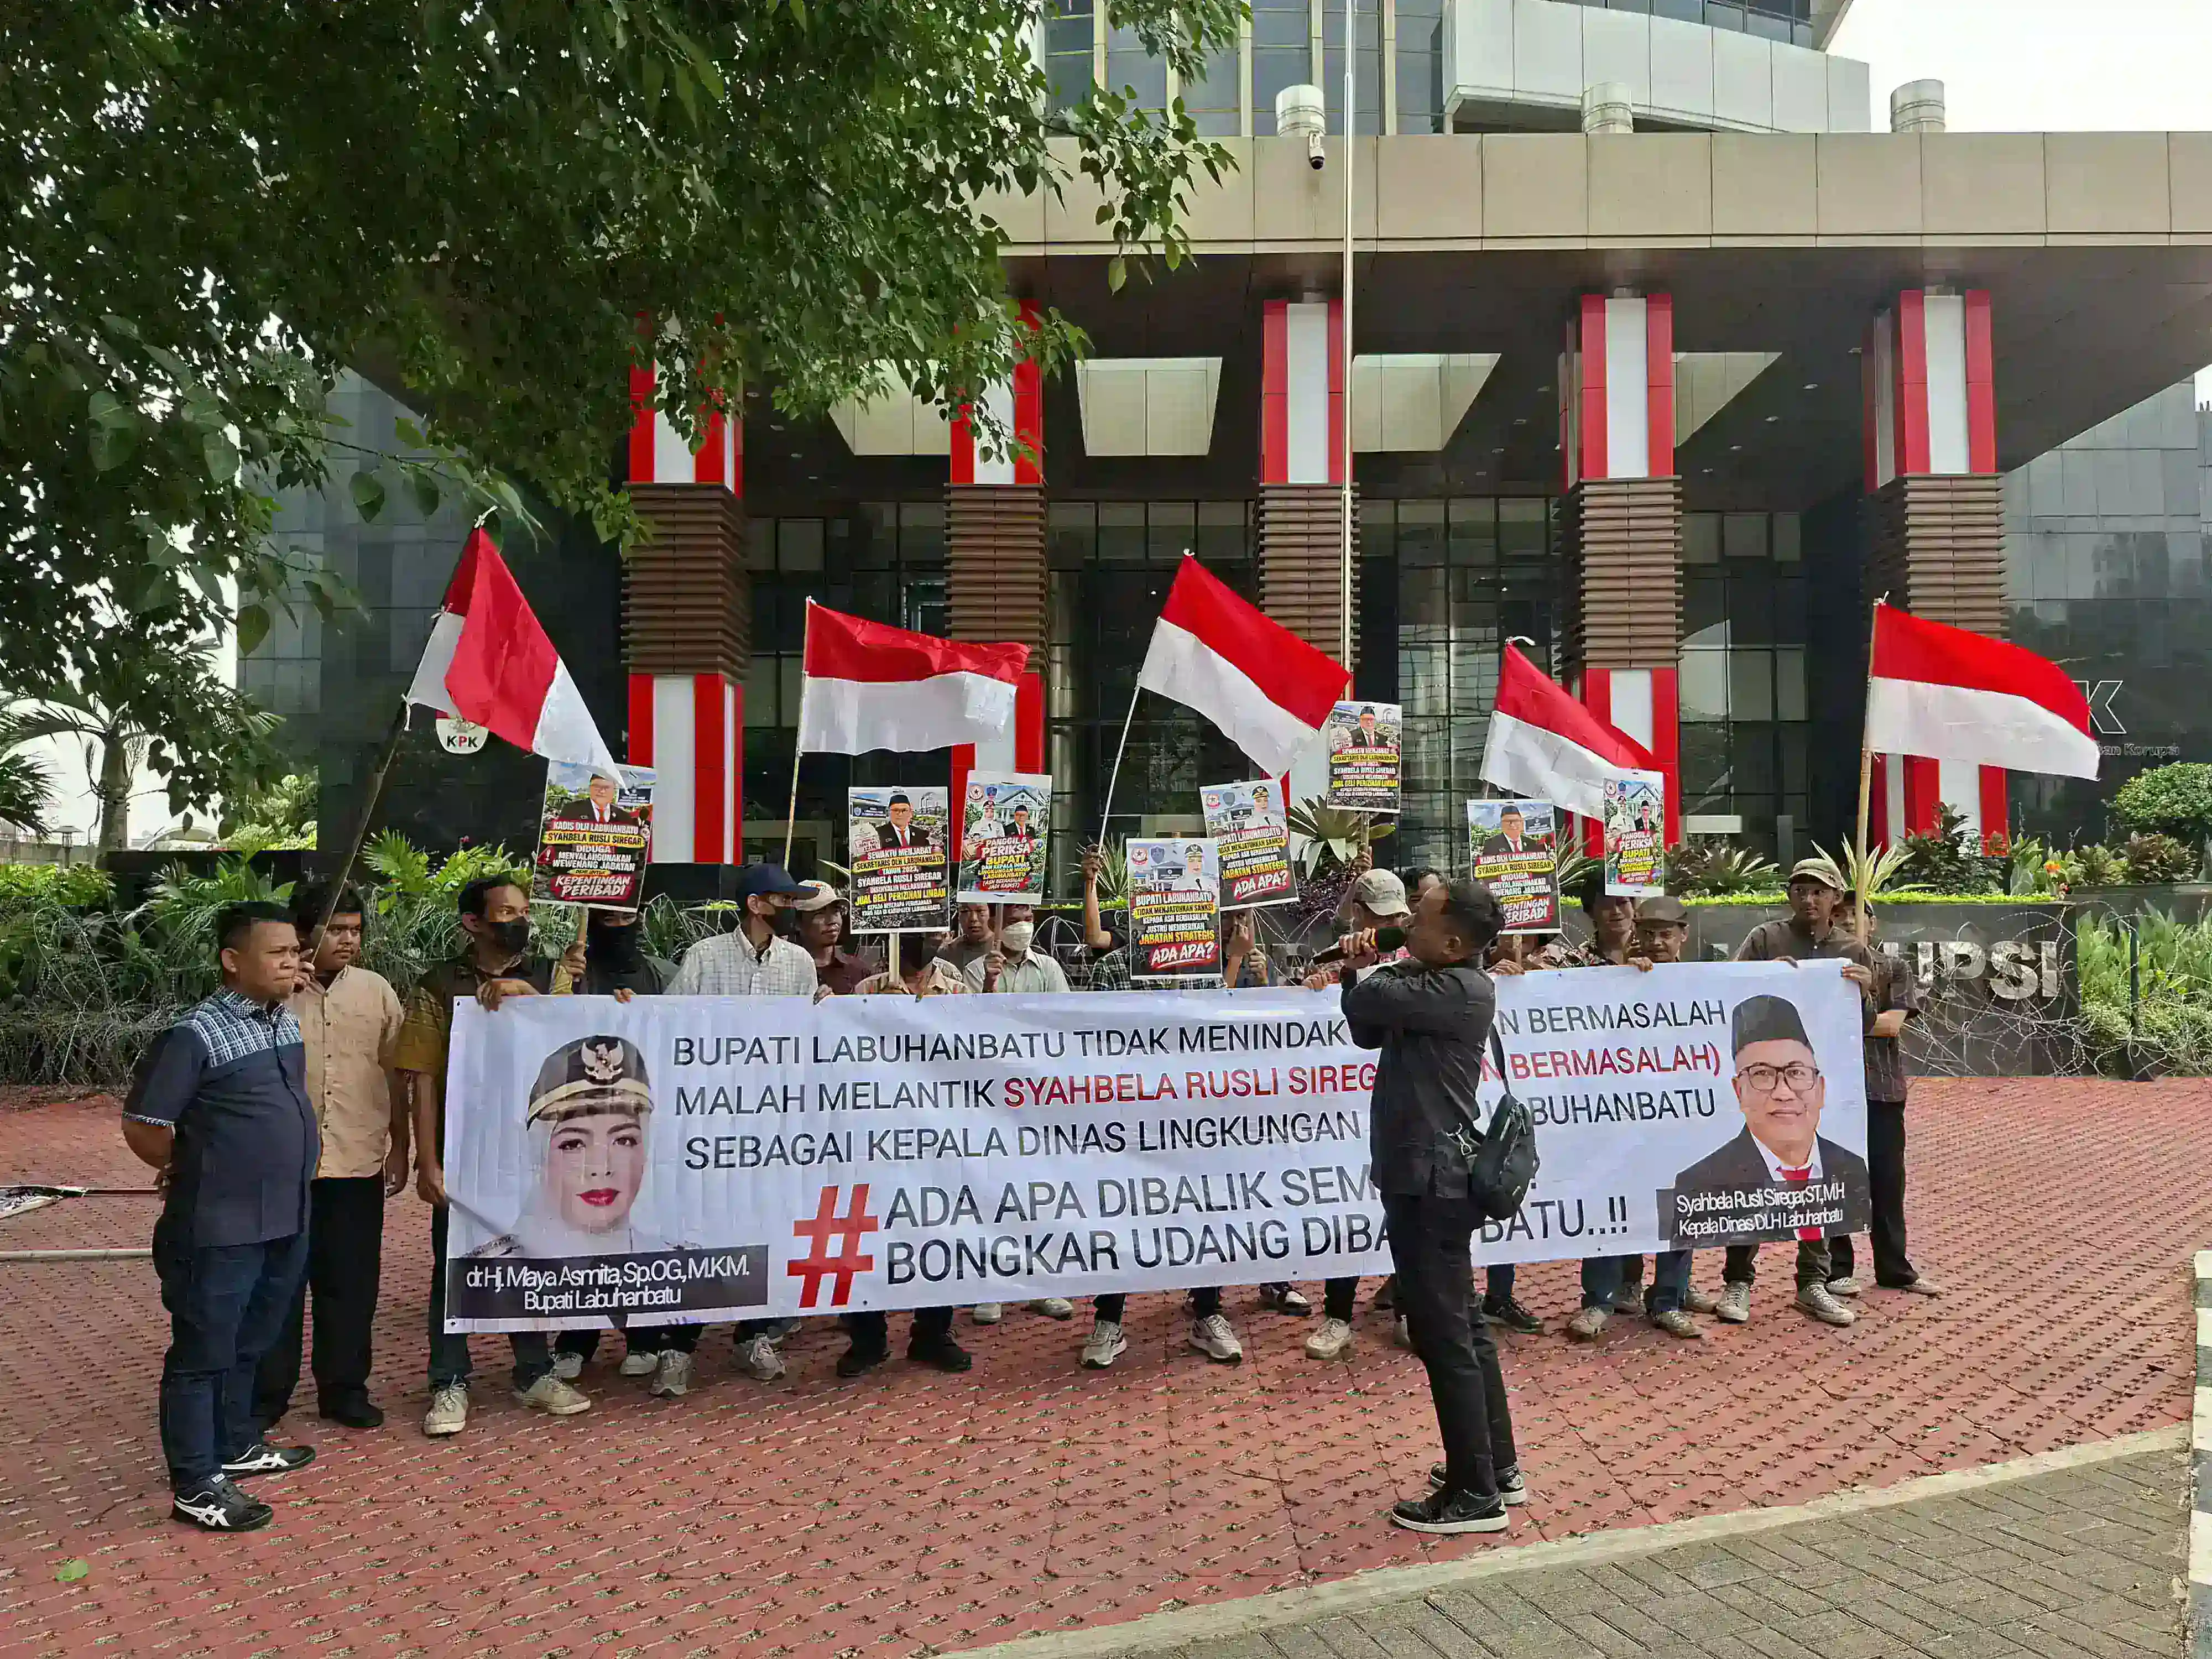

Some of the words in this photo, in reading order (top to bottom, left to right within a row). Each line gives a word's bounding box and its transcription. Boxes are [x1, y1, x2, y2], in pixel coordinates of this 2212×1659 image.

[447, 735, 478, 748] KPK
[554, 822, 574, 830] KADIS
[547, 832, 587, 842] SYAHBELA
[588, 833, 611, 843] RUSLI
[612, 835, 641, 846] SIREGAR
[985, 837, 1019, 847] PANGGIL
[1619, 837, 1653, 852] PERIKSA
[867, 850, 898, 860] SEWAKTU
[982, 844, 1031, 858] PERIKSA
[1623, 848, 1650, 859] BUPATI
[553, 859, 598, 869] WEWENANG
[857, 858, 890, 870] SEKRETARIS
[904, 855, 943, 865] LABUHANBATU
[986, 855, 1025, 865] BUPATI
[1222, 867, 1251, 879] JABATAN
[1251, 860, 1287, 874] STRATEGIS
[1478, 864, 1509, 875] SYAHBELA
[1509, 863, 1526, 872] RUSLI
[1527, 861, 1551, 870] SIREGAR
[555, 875, 631, 886] KEPENTINGAN
[857, 875, 892, 888] SYAHBELA
[893, 873, 912, 883] RUSLI
[914, 871, 942, 881] SIREGAR
[1234, 878, 1256, 897] ADA
[1258, 870, 1288, 890] APA?
[1500, 872, 1529, 882] DIDUGA
[561, 884, 626, 898] PERIBADI
[855, 895, 872, 906] JUAL
[873, 892, 887, 903] BELI
[888, 889, 922, 902] PERIZINAN
[922, 887, 946, 899] LIMBAH
[1491, 886, 1522, 896] WENANG
[1523, 884, 1551, 894] JABATAN
[1135, 894, 1162, 906] BUPATI
[1162, 891, 1212, 904] LABUHANBATU
[1501, 896, 1550, 911] PENTINGAN
[1136, 908, 1153, 916] TIDAK
[1154, 905, 1193, 915] MENJATUHKAN
[1194, 904, 1213, 912] SANKSI
[1503, 906, 1548, 924] ERIBADI
[1146, 924, 1168, 933] JUSTRU
[1168, 922, 1205, 931] MEMBERIKAN
[1139, 932, 1174, 945] JABATAN
[1175, 929, 1215, 942] STRATEGIS
[1151, 946, 1177, 966] ADA
[1180, 941, 1215, 960] APA?
[1528, 999, 1726, 1035] BERMASALAH
[674, 1035, 801, 1066] BUPATI
[812, 1031, 1065, 1063] LABUHANBATU
[1074, 1026, 1170, 1057] TIDAK
[1179, 1019, 1348, 1053] MENINDAK
[1510, 1041, 1721, 1080] BERMASALAH)
[675, 1084, 805, 1116] MALAH
[818, 1078, 996, 1112] MELANTIK
[1004, 1073, 1178, 1108] SYAHBELA
[1185, 1067, 1279, 1100] RUSLI
[1288, 1062, 1378, 1095] SIREG
[1485, 1087, 1715, 1126] BUHANBATU
[684, 1130, 852, 1171] SEBAGAI
[868, 1126, 1008, 1162] KEPALA
[1018, 1120, 1126, 1156] DINAS
[1138, 1110, 1363, 1152] LINGKUNGAN
[884, 1184, 984, 1230] ADA
[993, 1180, 1088, 1224] APA
[1097, 1170, 1274, 1218] DIBALIK
[1280, 1163, 1378, 1207] SEM
[1676, 1190, 1734, 1217] Syahbela
[1734, 1188, 1764, 1208] Rusli
[1678, 1216, 1719, 1239] Kepala
[1718, 1215, 1755, 1233] Dinas
[1754, 1212, 1782, 1231] DLH
[1783, 1207, 1844, 1228] Labuhanbatu
[786, 1182, 879, 1309] #
[886, 1229, 1120, 1285] BONGKAR
[1131, 1218, 1290, 1269] UDANG
[1302, 1212, 1389, 1258] DIBA
[506, 1265, 557, 1293] Maya
[524, 1290, 573, 1314] Bupati
[576, 1285, 681, 1309] Labuhanbatu
